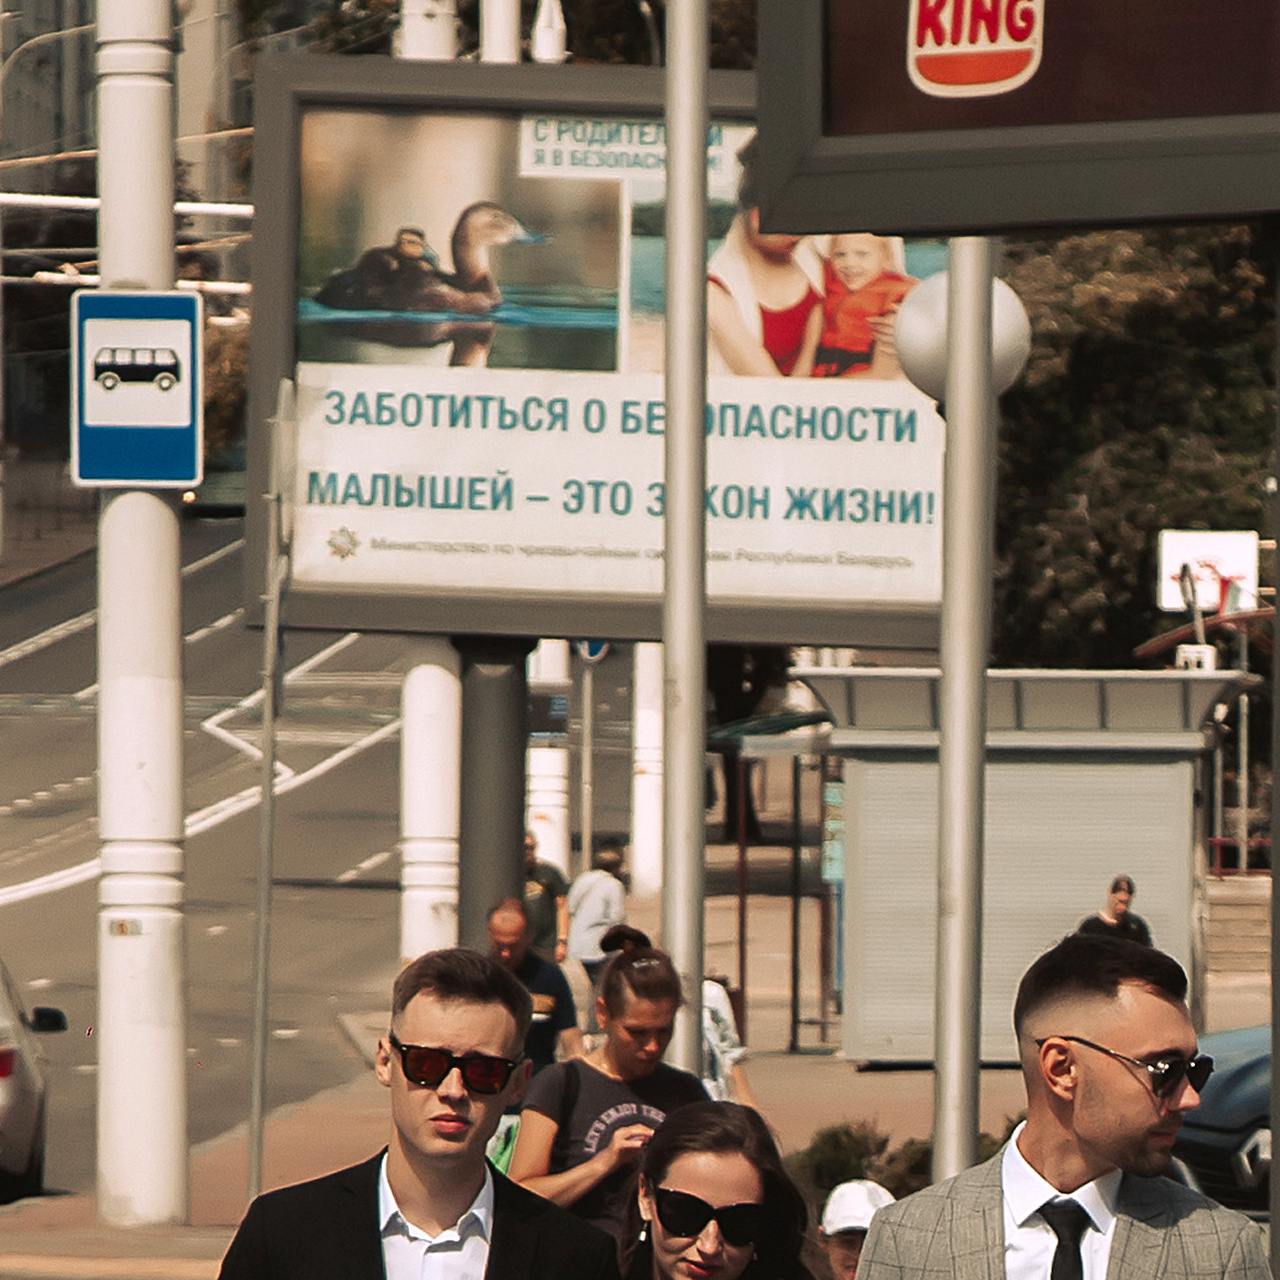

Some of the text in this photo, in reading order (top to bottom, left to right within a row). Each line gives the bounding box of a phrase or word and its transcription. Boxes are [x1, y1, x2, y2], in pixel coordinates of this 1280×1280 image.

[916, 0, 1035, 47] KING
[534, 119, 723, 147] С РОДИТЕИ
[325, 389, 918, 443] ЗАБОТИТЬСЯ О БЕПАСНОСТИ
[307, 468, 514, 512] МАЛЫШЕЙ
[563, 479, 633, 516] ЭТО
[646, 481, 771, 520] ЗКОН
[784, 486, 935, 525] ЖИЗНИ!
